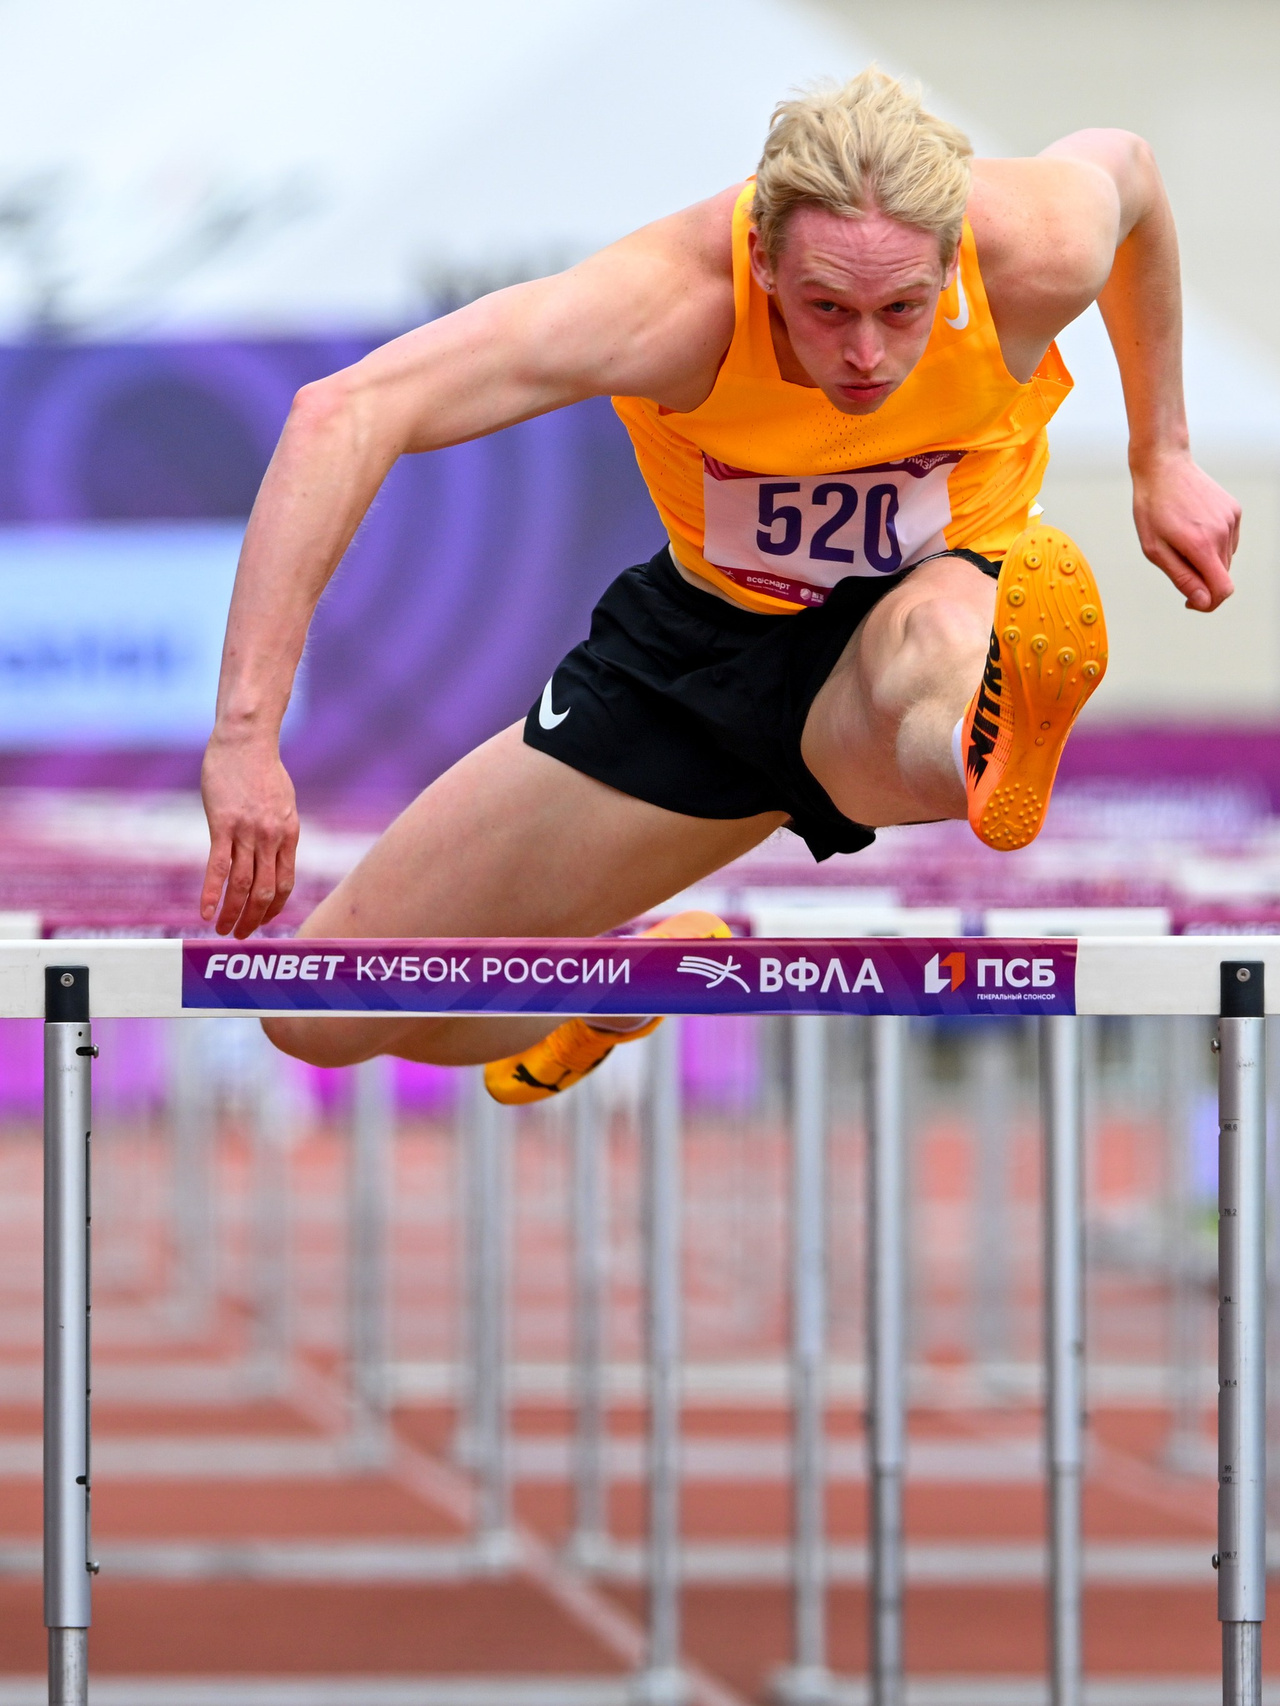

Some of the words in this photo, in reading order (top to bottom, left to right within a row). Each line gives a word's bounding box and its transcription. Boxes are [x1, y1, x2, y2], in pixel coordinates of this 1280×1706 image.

[756, 482, 902, 573] 520
[204, 953, 345, 980] FONBET
[356, 956, 472, 983] КУБОК
[482, 957, 630, 984] РОССИИ
[760, 956, 884, 993] ВФЛА
[977, 958, 1056, 988] ПСБ
